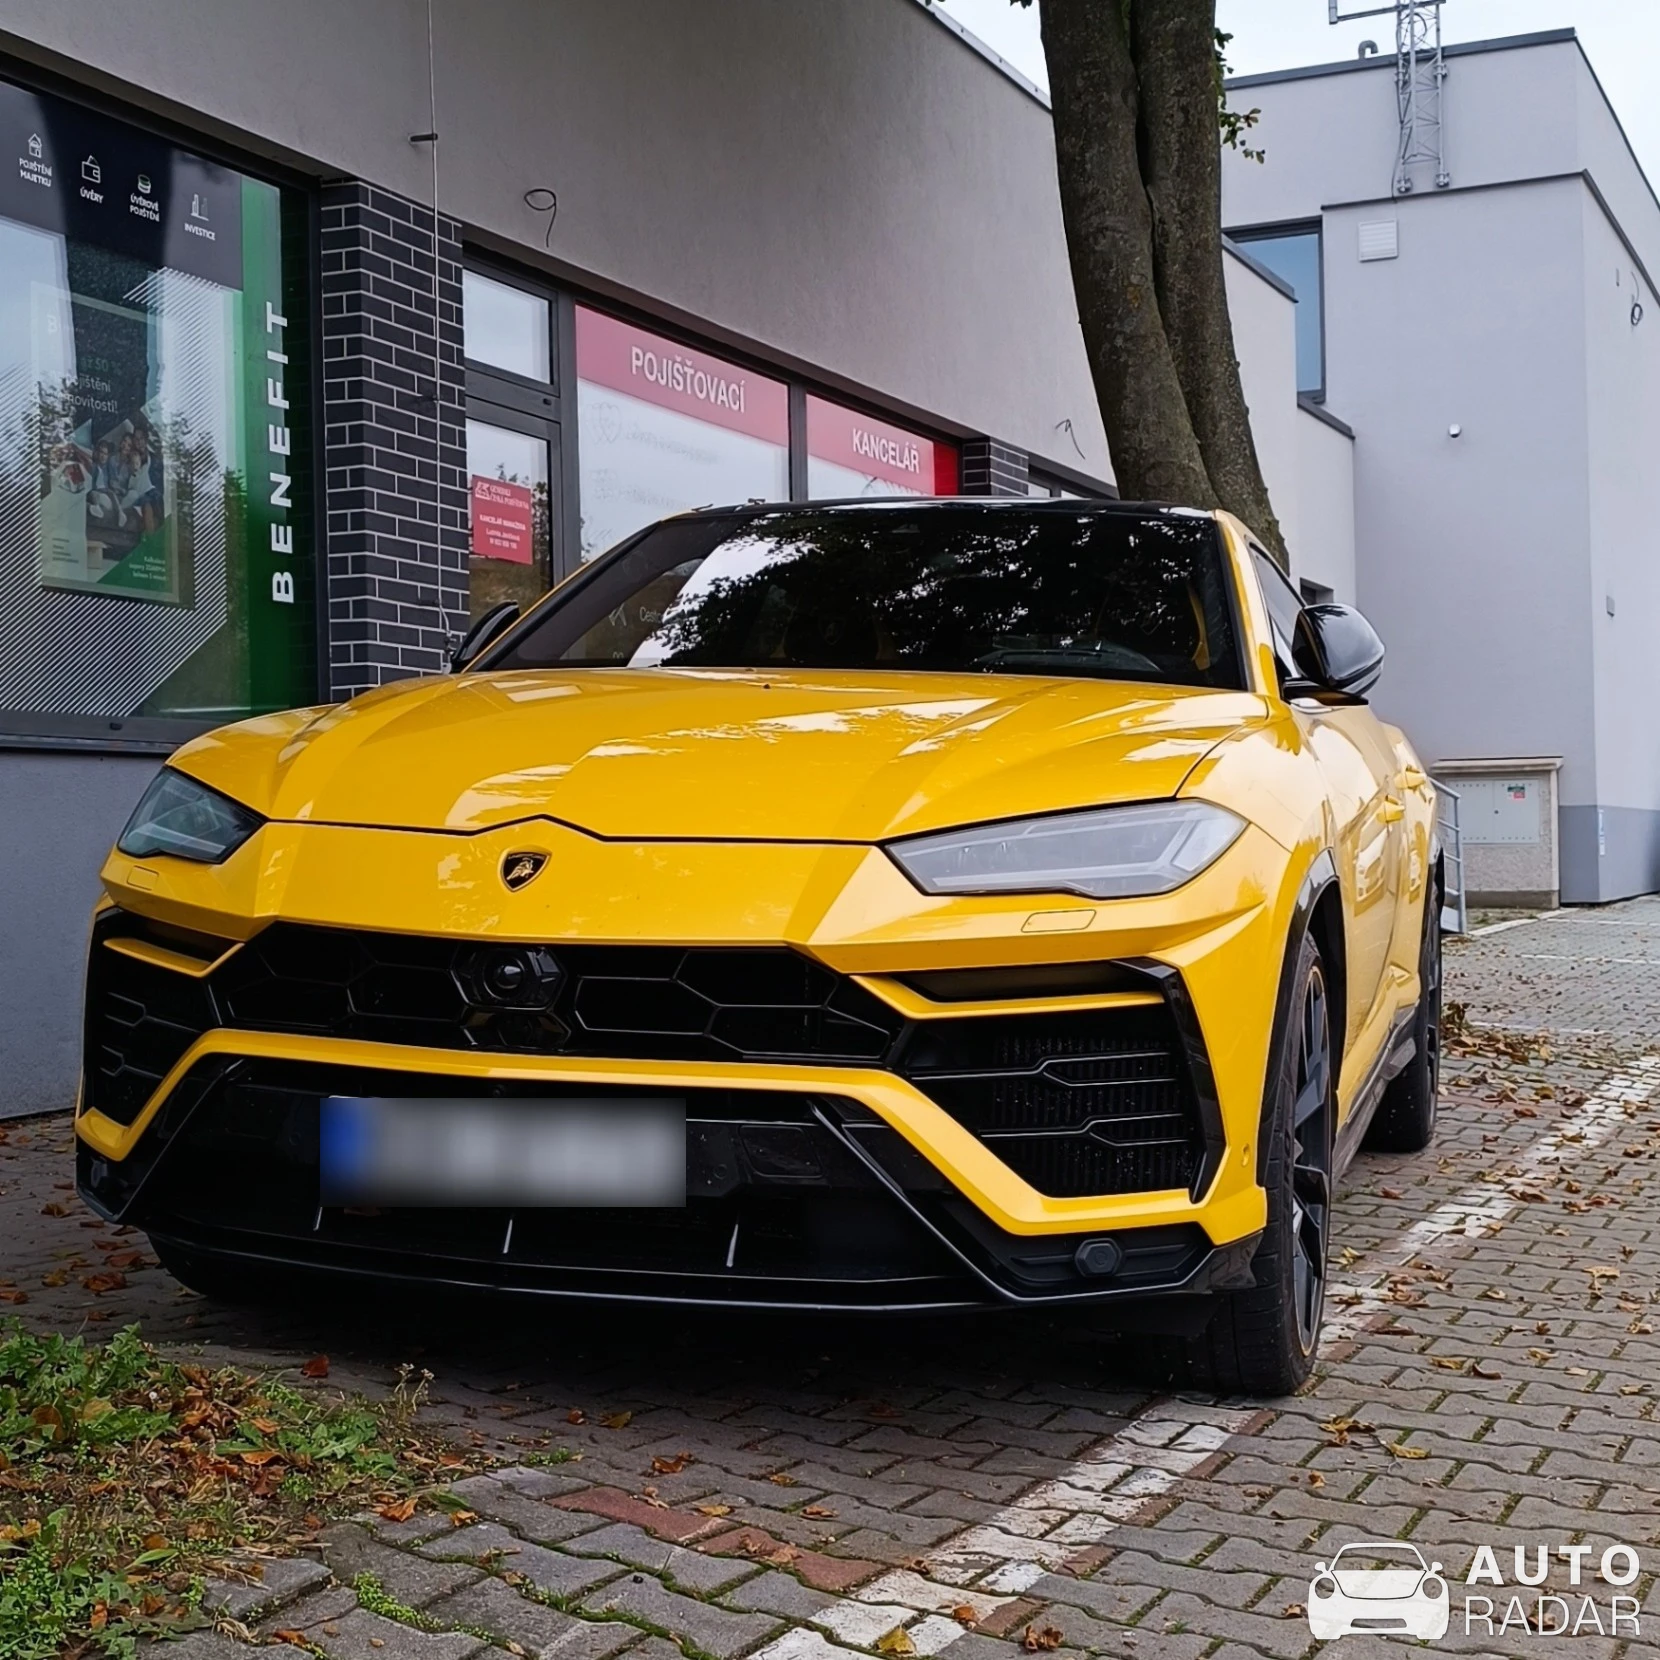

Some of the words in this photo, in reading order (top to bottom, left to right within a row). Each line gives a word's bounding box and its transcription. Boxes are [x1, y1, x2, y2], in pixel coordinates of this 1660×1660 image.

[80, 186, 104, 204] ÚVĚRY
[184, 222, 216, 241] INVESTICE
[631, 345, 745, 414] POJIŠŤOVACÍ
[266, 301, 294, 604] BENEFIT
[852, 427, 920, 474] KANCELÁŘ
